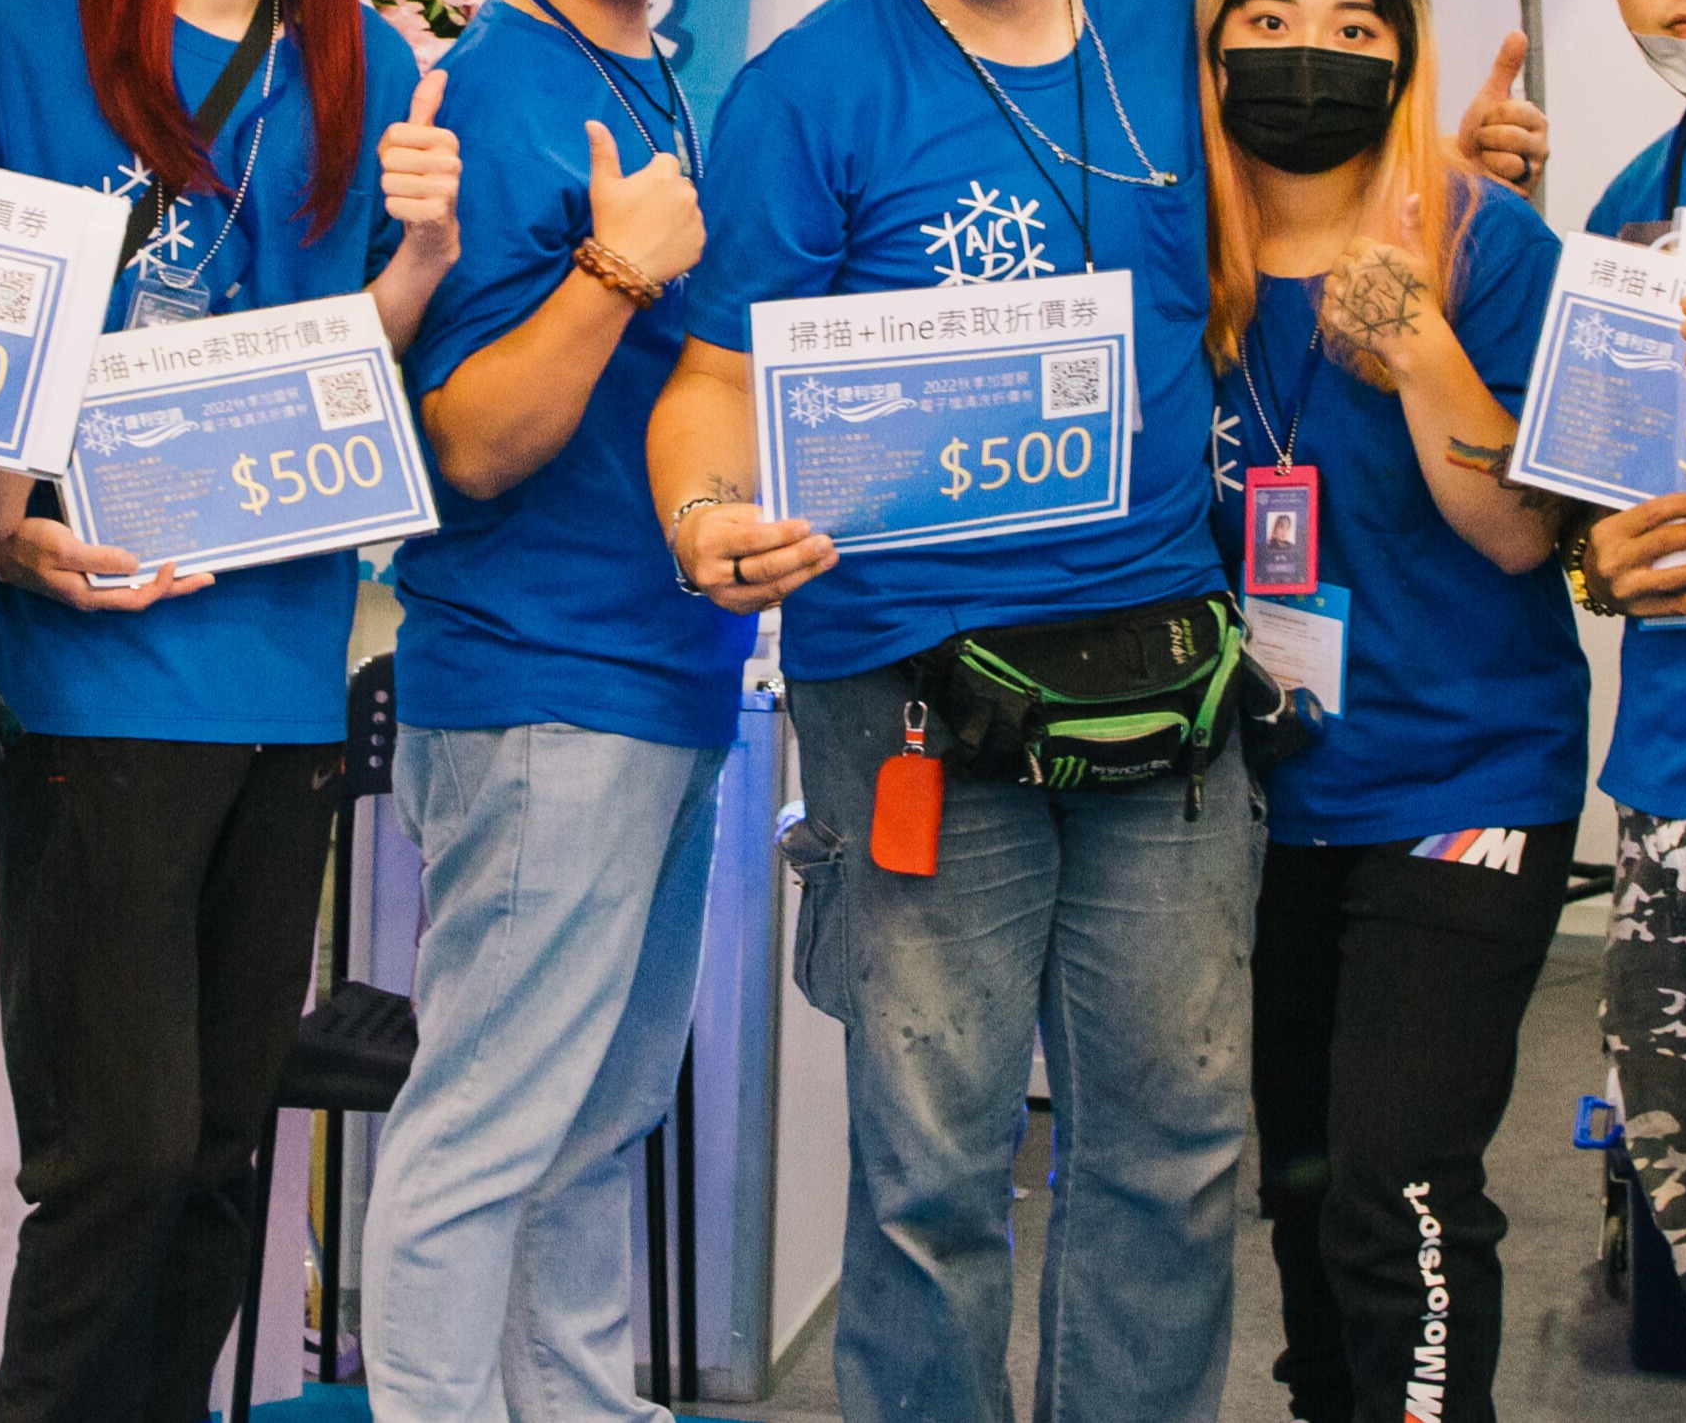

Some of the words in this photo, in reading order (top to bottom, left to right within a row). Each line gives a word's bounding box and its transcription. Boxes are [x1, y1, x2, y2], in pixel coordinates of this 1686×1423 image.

[964, 216, 1018, 257] A/C
[978, 252, 1016, 280] D
[787, 296, 1101, 353] 掃描+line索取折價券
[230, 434, 385, 517] $500
[938, 425, 1094, 502] $500
